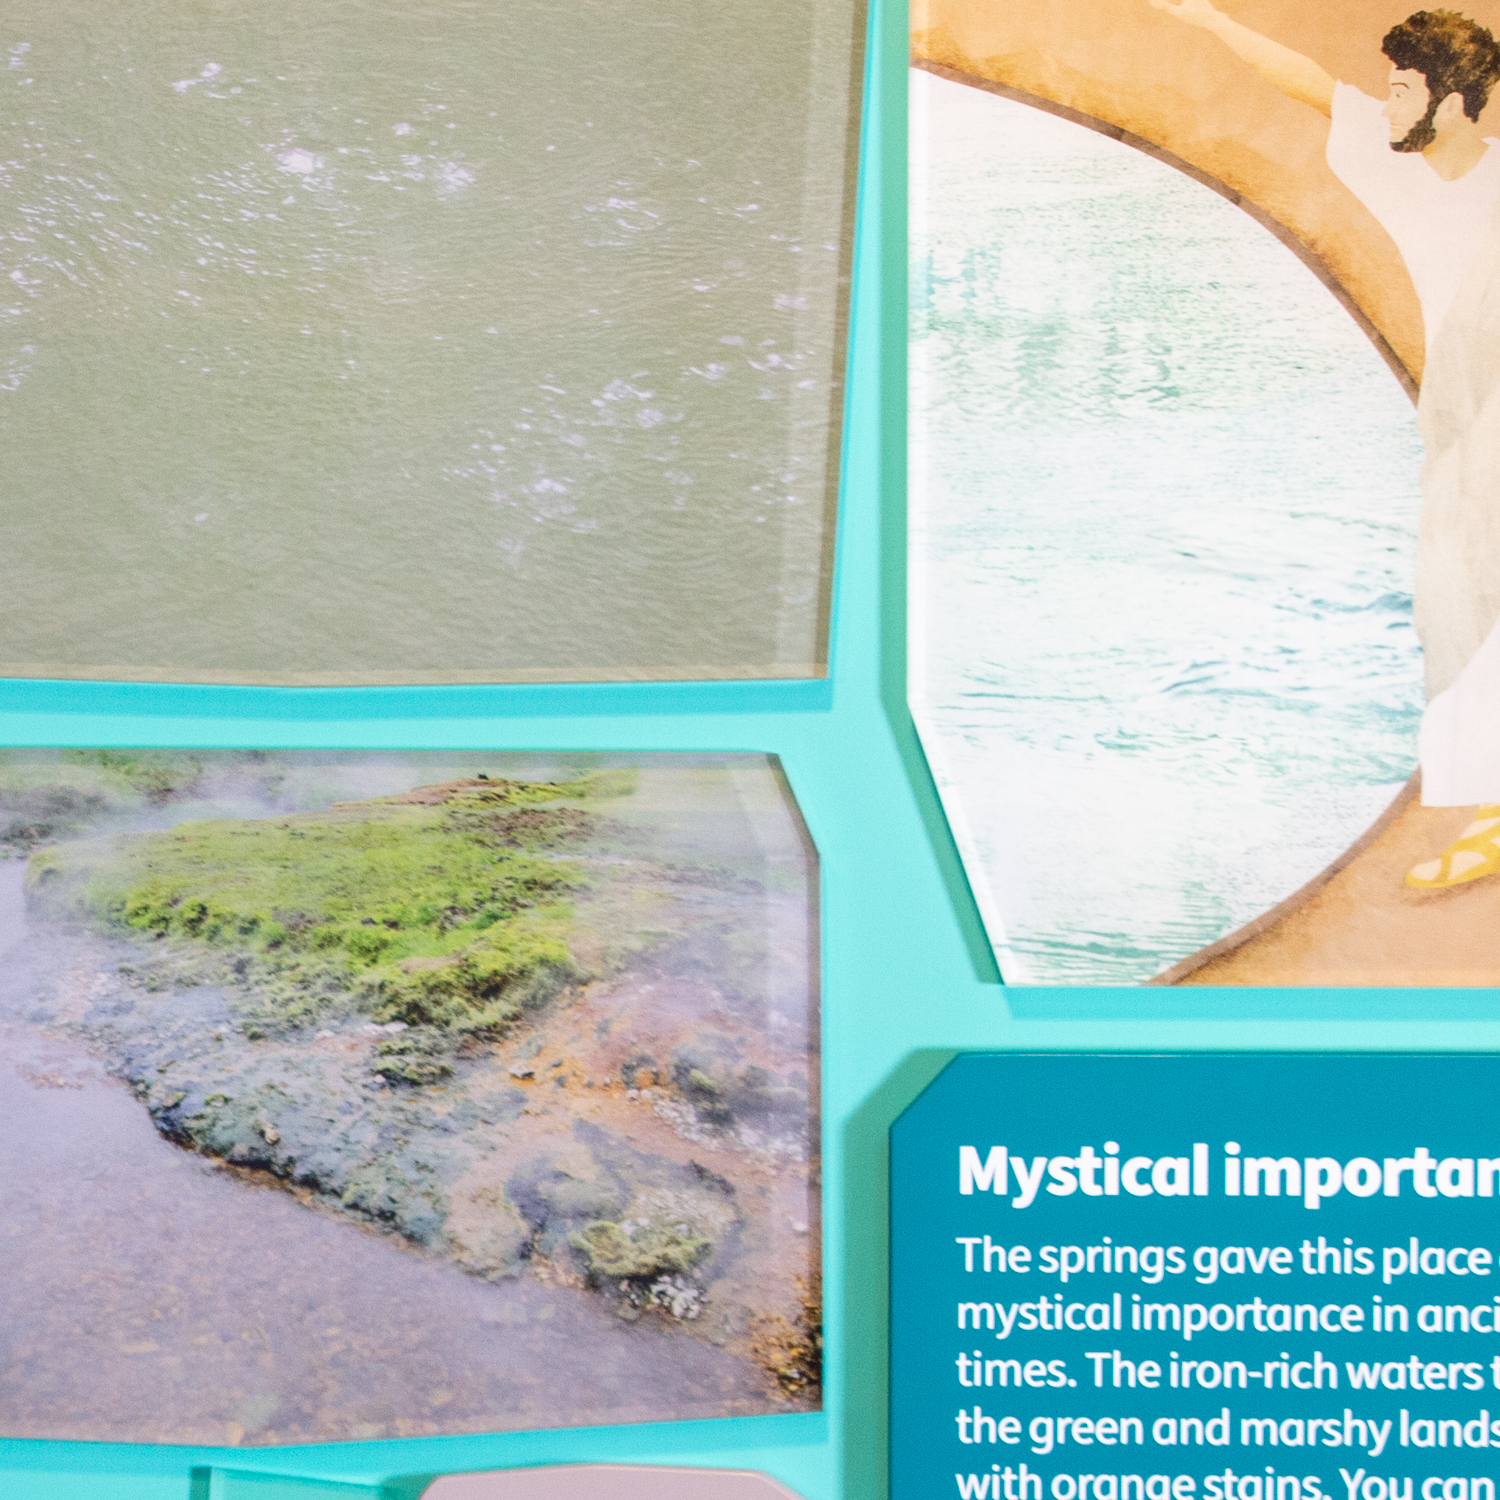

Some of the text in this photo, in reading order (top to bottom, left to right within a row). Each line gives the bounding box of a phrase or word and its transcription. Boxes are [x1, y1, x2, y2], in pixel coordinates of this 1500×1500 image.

[960, 1141, 1208, 1209] Mystical
[956, 1235, 1492, 1284] The springs gave this place
[958, 1293, 1121, 1339] mystical
[1132, 1294, 1364, 1340] importance
[1373, 1295, 1408, 1332] in
[956, 1350, 1077, 1387] times.
[1085, 1350, 1161, 1388] The
[1170, 1351, 1337, 1389] iron-rich
[1346, 1355, 1484, 1390] waters
[955, 1406, 1021, 1444] the
[1029, 1417, 1143, 1454] green
[1153, 1408, 1230, 1446] and
[1241, 1408, 1392, 1456] marshy
[956, 1463, 1042, 1500] with
